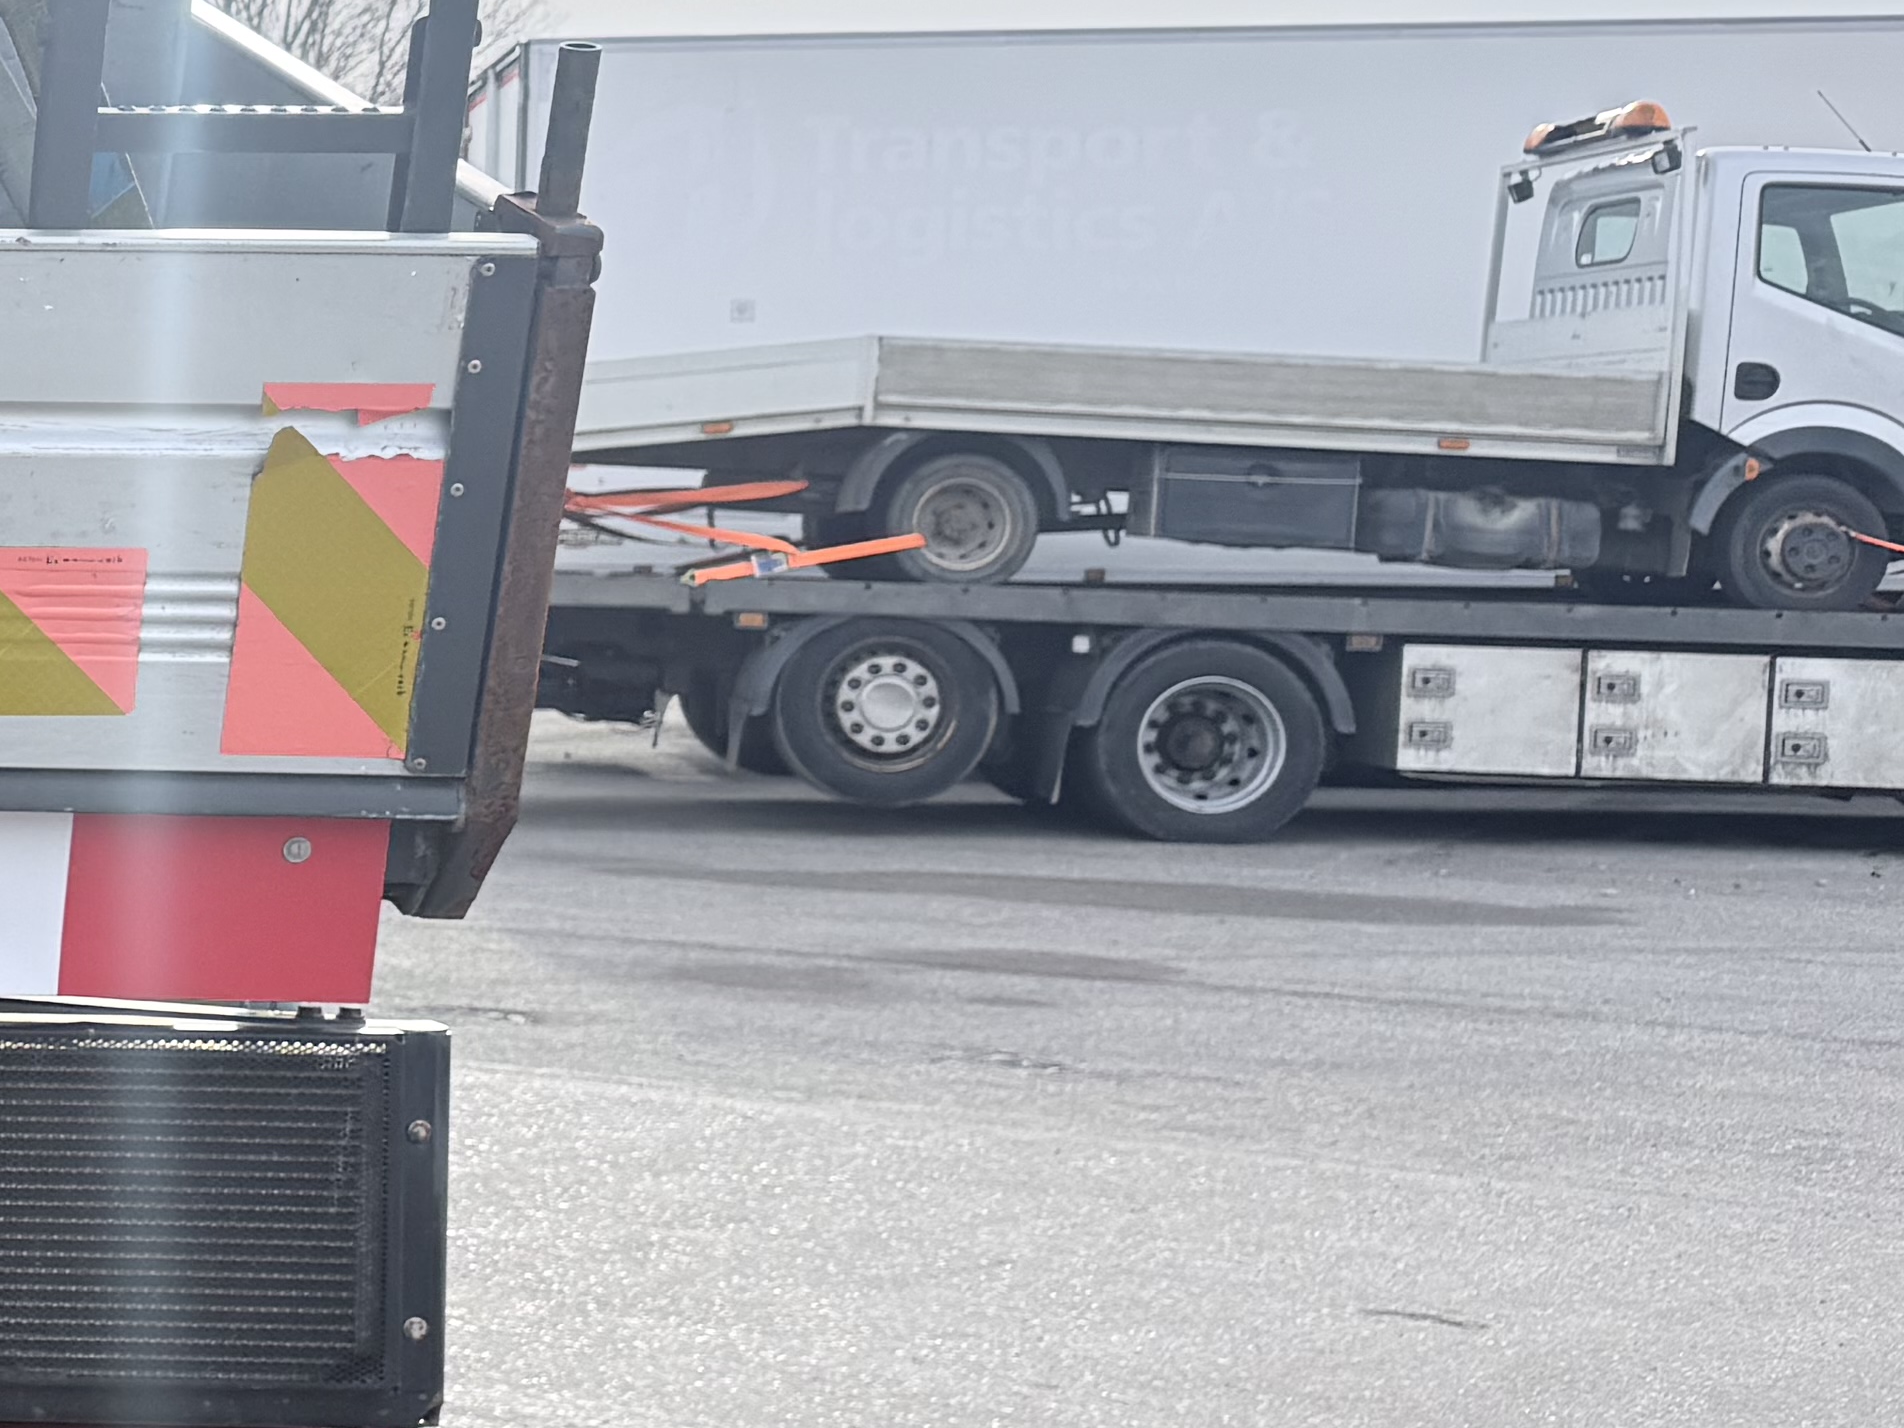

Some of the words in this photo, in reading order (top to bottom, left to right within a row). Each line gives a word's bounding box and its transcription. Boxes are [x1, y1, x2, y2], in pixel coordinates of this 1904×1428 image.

[802, 111, 1221, 186] Transport
[1253, 108, 1316, 170] &
[813, 187, 1160, 267] logistics
